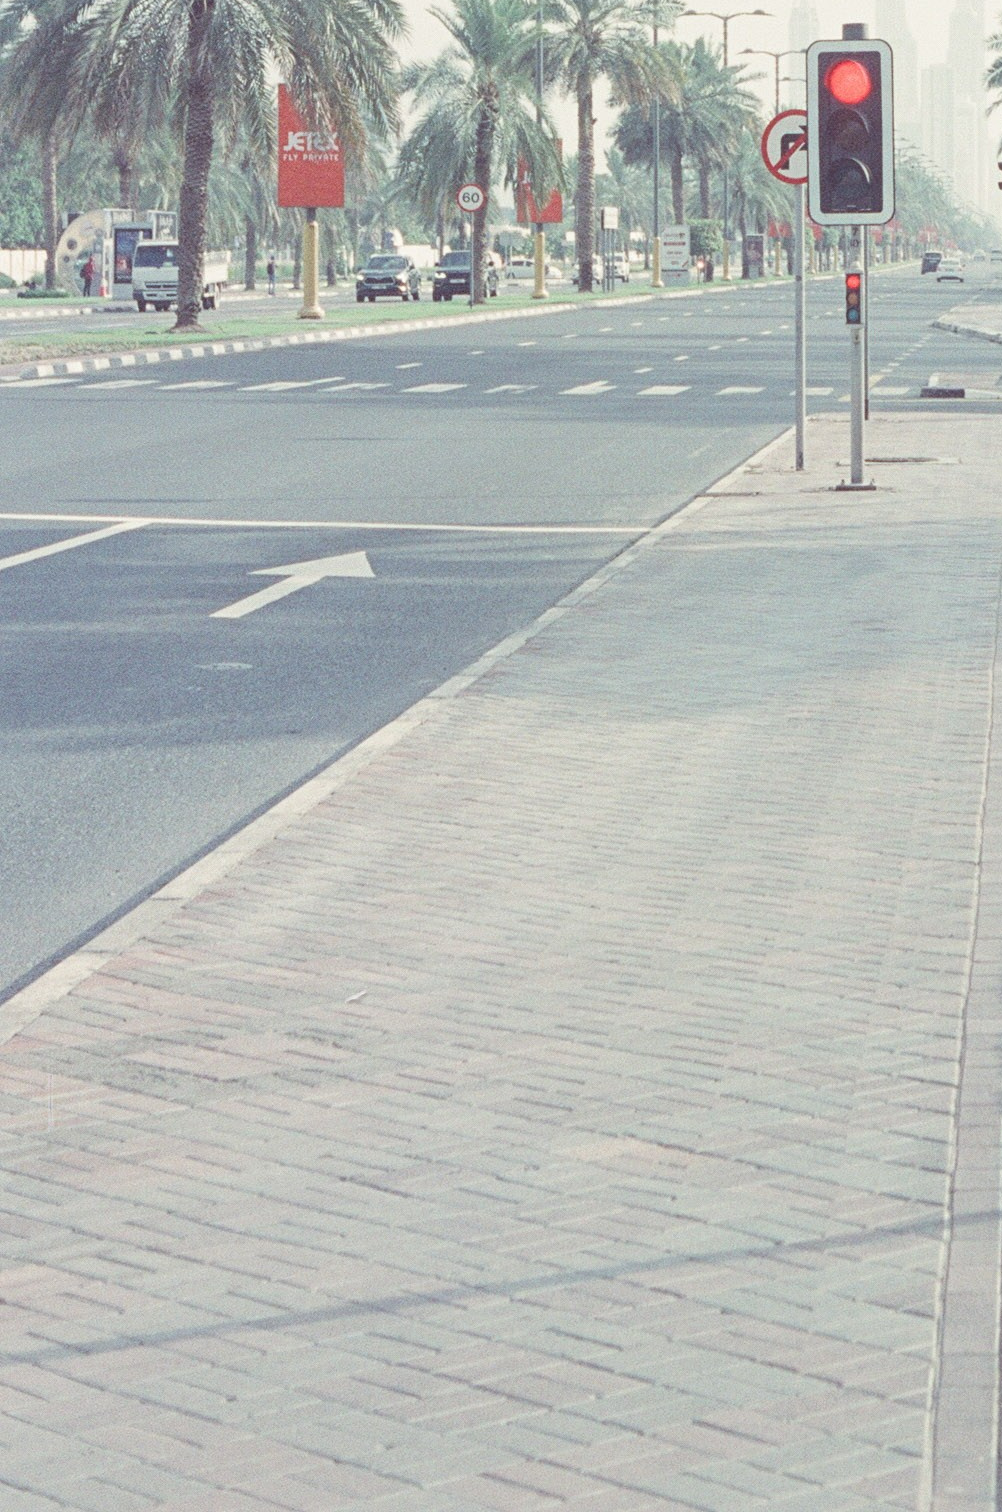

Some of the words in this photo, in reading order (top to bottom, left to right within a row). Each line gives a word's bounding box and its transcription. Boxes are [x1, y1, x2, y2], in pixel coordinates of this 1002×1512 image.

[283, 153, 298, 161] FLY
[302, 153, 339, 162] PRIVATE
[462, 192, 480, 203] 60
